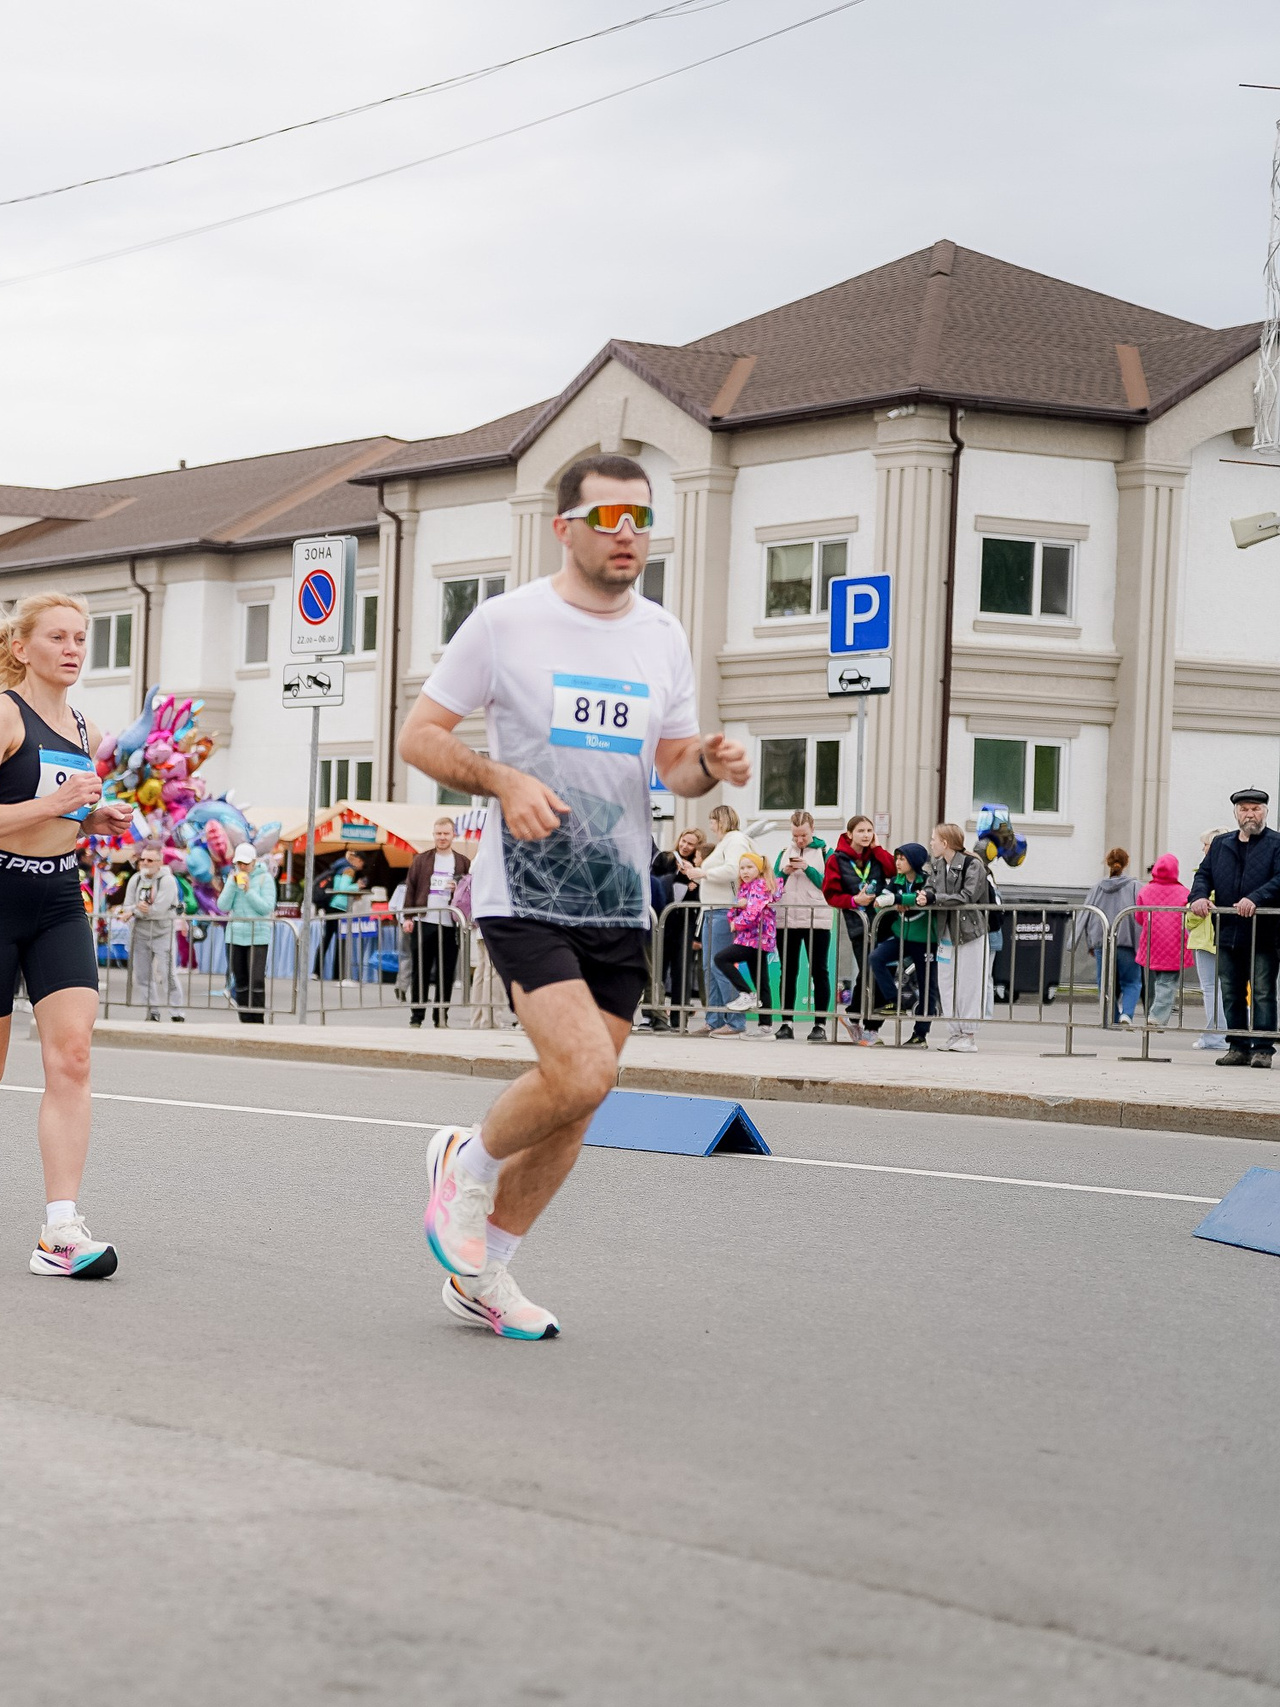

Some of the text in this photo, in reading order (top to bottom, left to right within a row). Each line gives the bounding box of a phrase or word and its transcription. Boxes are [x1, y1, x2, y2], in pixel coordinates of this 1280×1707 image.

[304, 547, 332, 560] ЗОНА
[845, 584, 880, 646] P
[574, 696, 629, 729] 818
[5, 857, 56, 875] PRO
